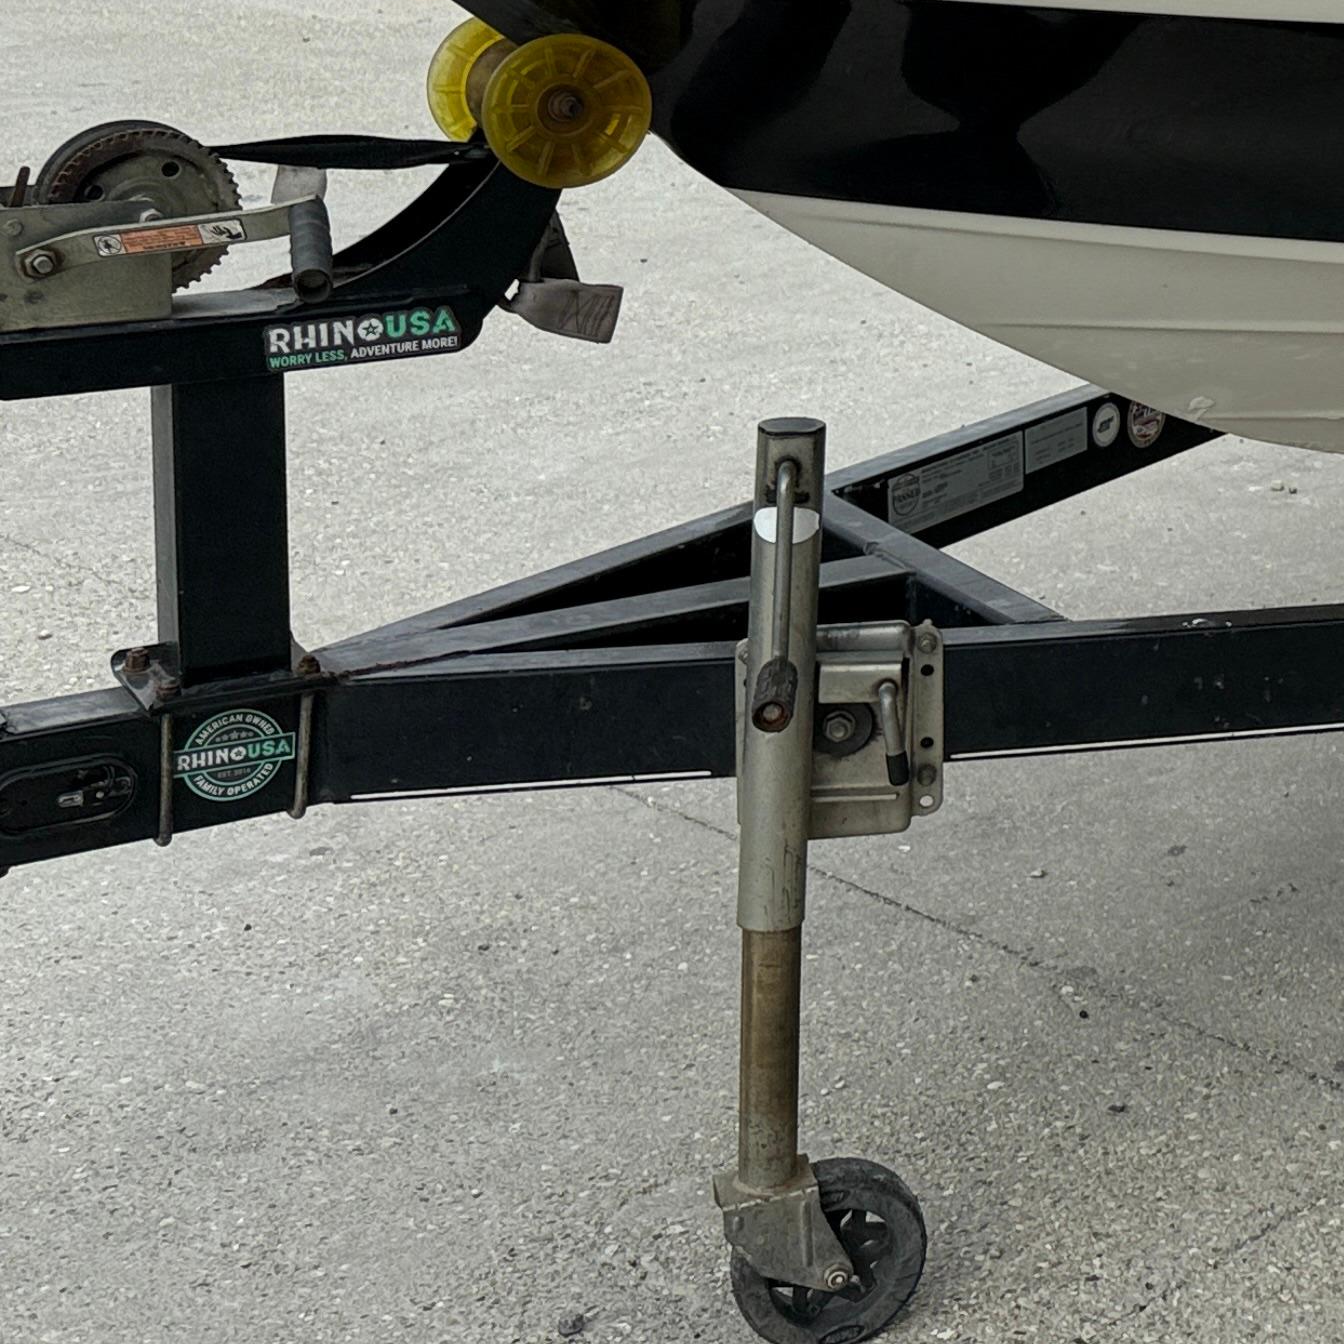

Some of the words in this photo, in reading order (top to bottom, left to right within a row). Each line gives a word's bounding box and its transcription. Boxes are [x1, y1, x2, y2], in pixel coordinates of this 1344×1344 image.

[269, 353, 313, 369] WORRY
[315, 350, 348, 363] LESS,
[350, 341, 419, 359] ADVENTURE
[422, 336, 458, 350] MORE!
[195, 714, 243, 745] AMERICAN
[245, 714, 275, 735] OWNED
[193, 775, 225, 795] FAMILY
[227, 763, 273, 796] OPERATED
